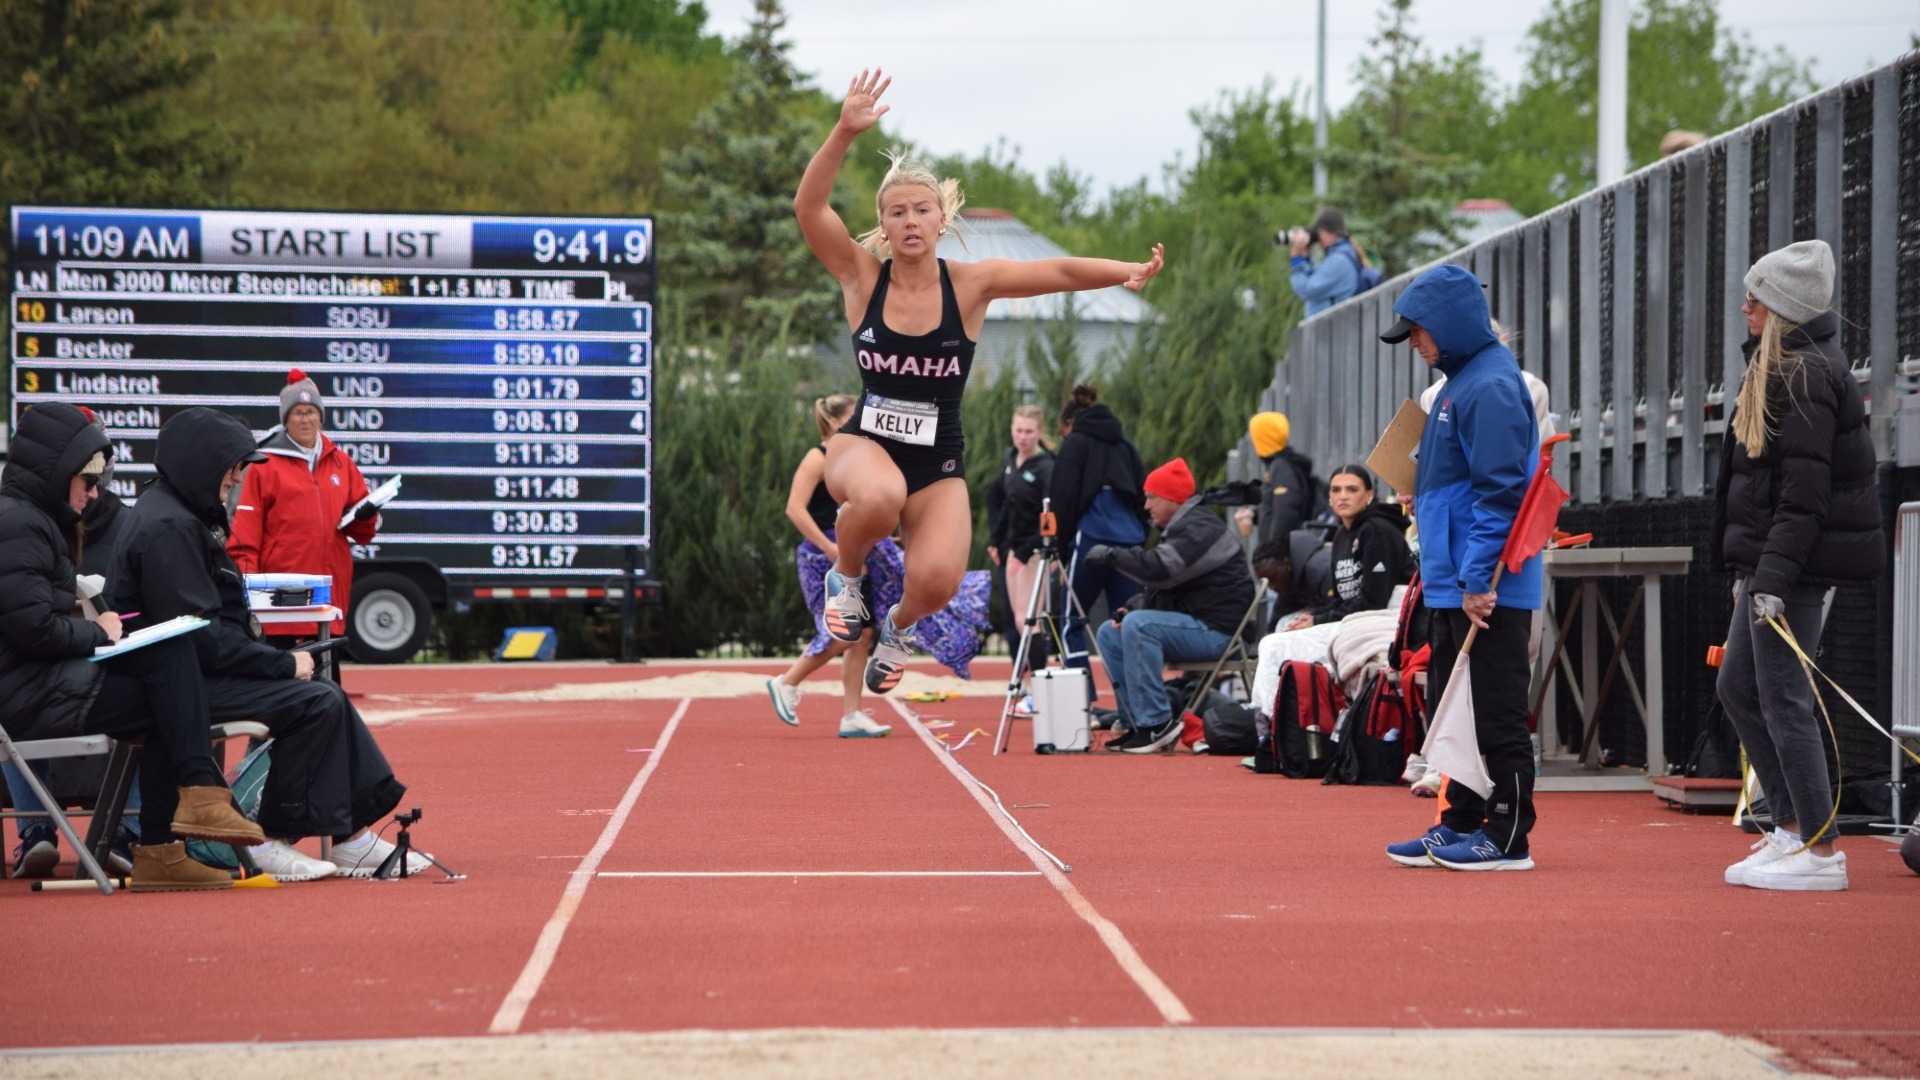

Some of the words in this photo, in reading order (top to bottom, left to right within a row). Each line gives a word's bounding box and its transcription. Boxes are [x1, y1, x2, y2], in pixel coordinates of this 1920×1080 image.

[34, 225, 125, 258] 11:09
[132, 227, 190, 258] AM
[231, 228, 349, 257] START
[364, 231, 439, 258] LIST
[533, 229, 647, 264] 9:41.9
[15, 270, 48, 291] LN
[60, 270, 107, 291] Men
[113, 271, 164, 292] 3000
[170, 272, 233, 294] Meter
[522, 279, 576, 299] TIME
[19, 302, 46, 323] 10
[56, 302, 135, 324] Larson
[326, 307, 390, 329] SDSU
[494, 309, 579, 331] 8:58.57
[631, 310, 643, 328] 1
[56, 337, 134, 359] Becker
[326, 342, 390, 363] SDSU
[494, 343, 579, 365] 8:59.10
[629, 344, 643, 363] 2
[858, 349, 962, 377] OMAHA
[24, 371, 40, 392] 3
[56, 372, 160, 394] Lindstrot
[332, 377, 384, 397] UND
[493, 378, 579, 400] 9:01.79
[631, 379, 644, 397] 3
[332, 410, 384, 430] UND
[493, 411, 579, 432] 9:08.19
[630, 412, 644, 432] 4
[874, 412, 924, 436] KELLY
[495, 443, 579, 465] 9:11.38
[494, 477, 579, 499] 9:11.48
[492, 512, 579, 533] 9:30.83
[492, 546, 578, 567] 9:31.57
